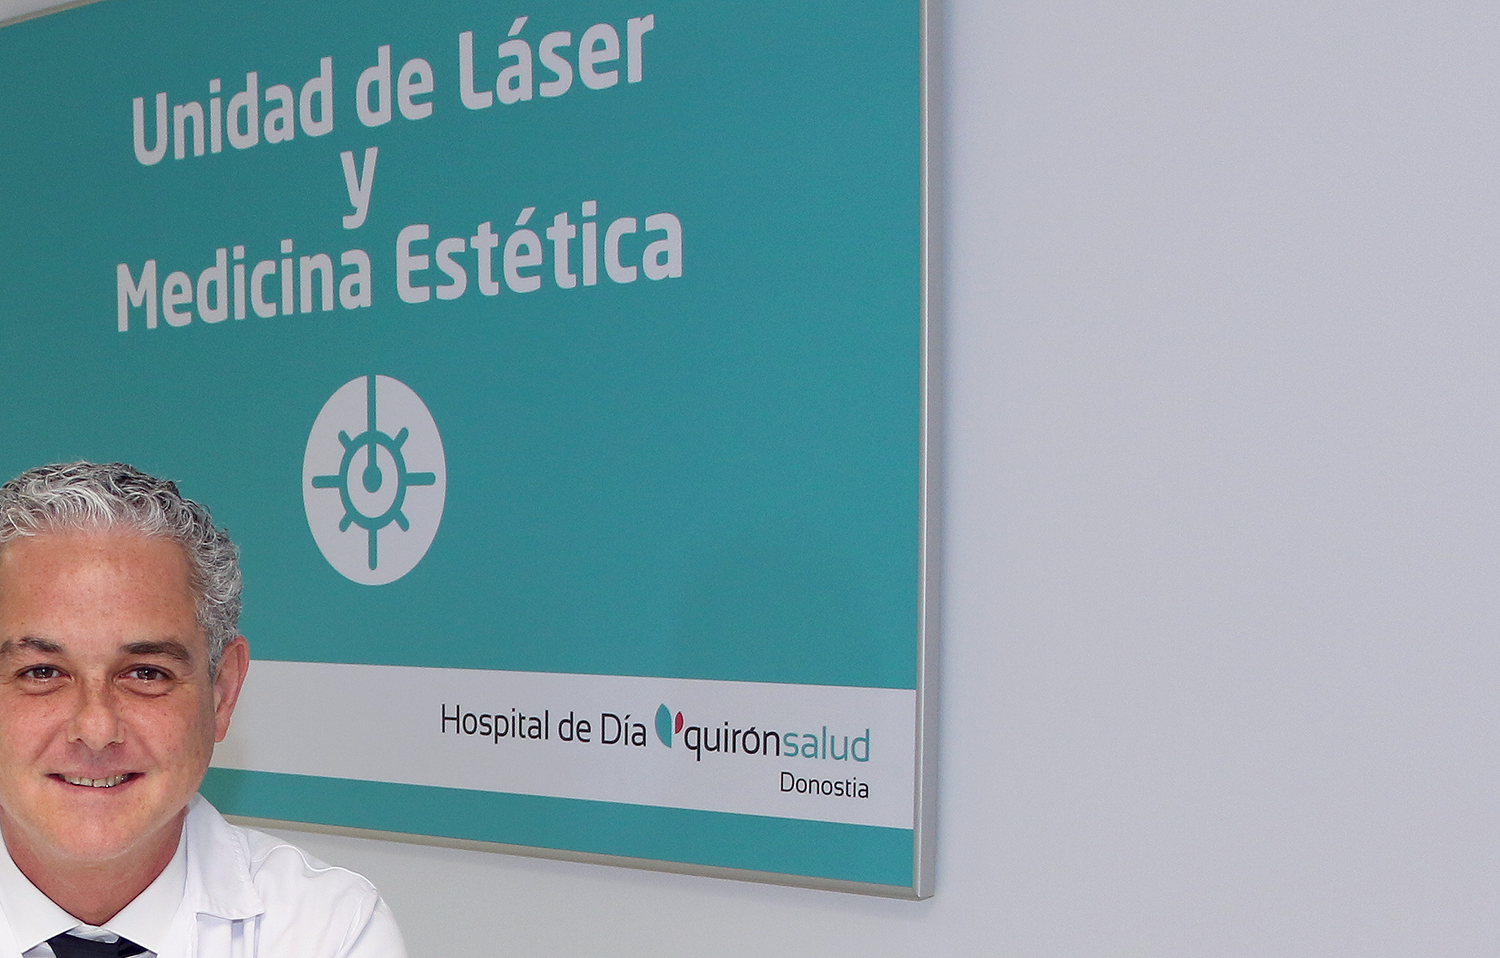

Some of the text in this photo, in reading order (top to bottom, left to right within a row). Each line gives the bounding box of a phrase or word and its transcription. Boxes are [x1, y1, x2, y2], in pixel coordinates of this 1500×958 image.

[132, 14, 655, 166] Unidad de Láser
[340, 147, 378, 229] y
[116, 202, 684, 333] Medicina Estética
[441, 703, 870, 762] Hospital de Día quirónsalud
[780, 771, 869, 798] Donostia
